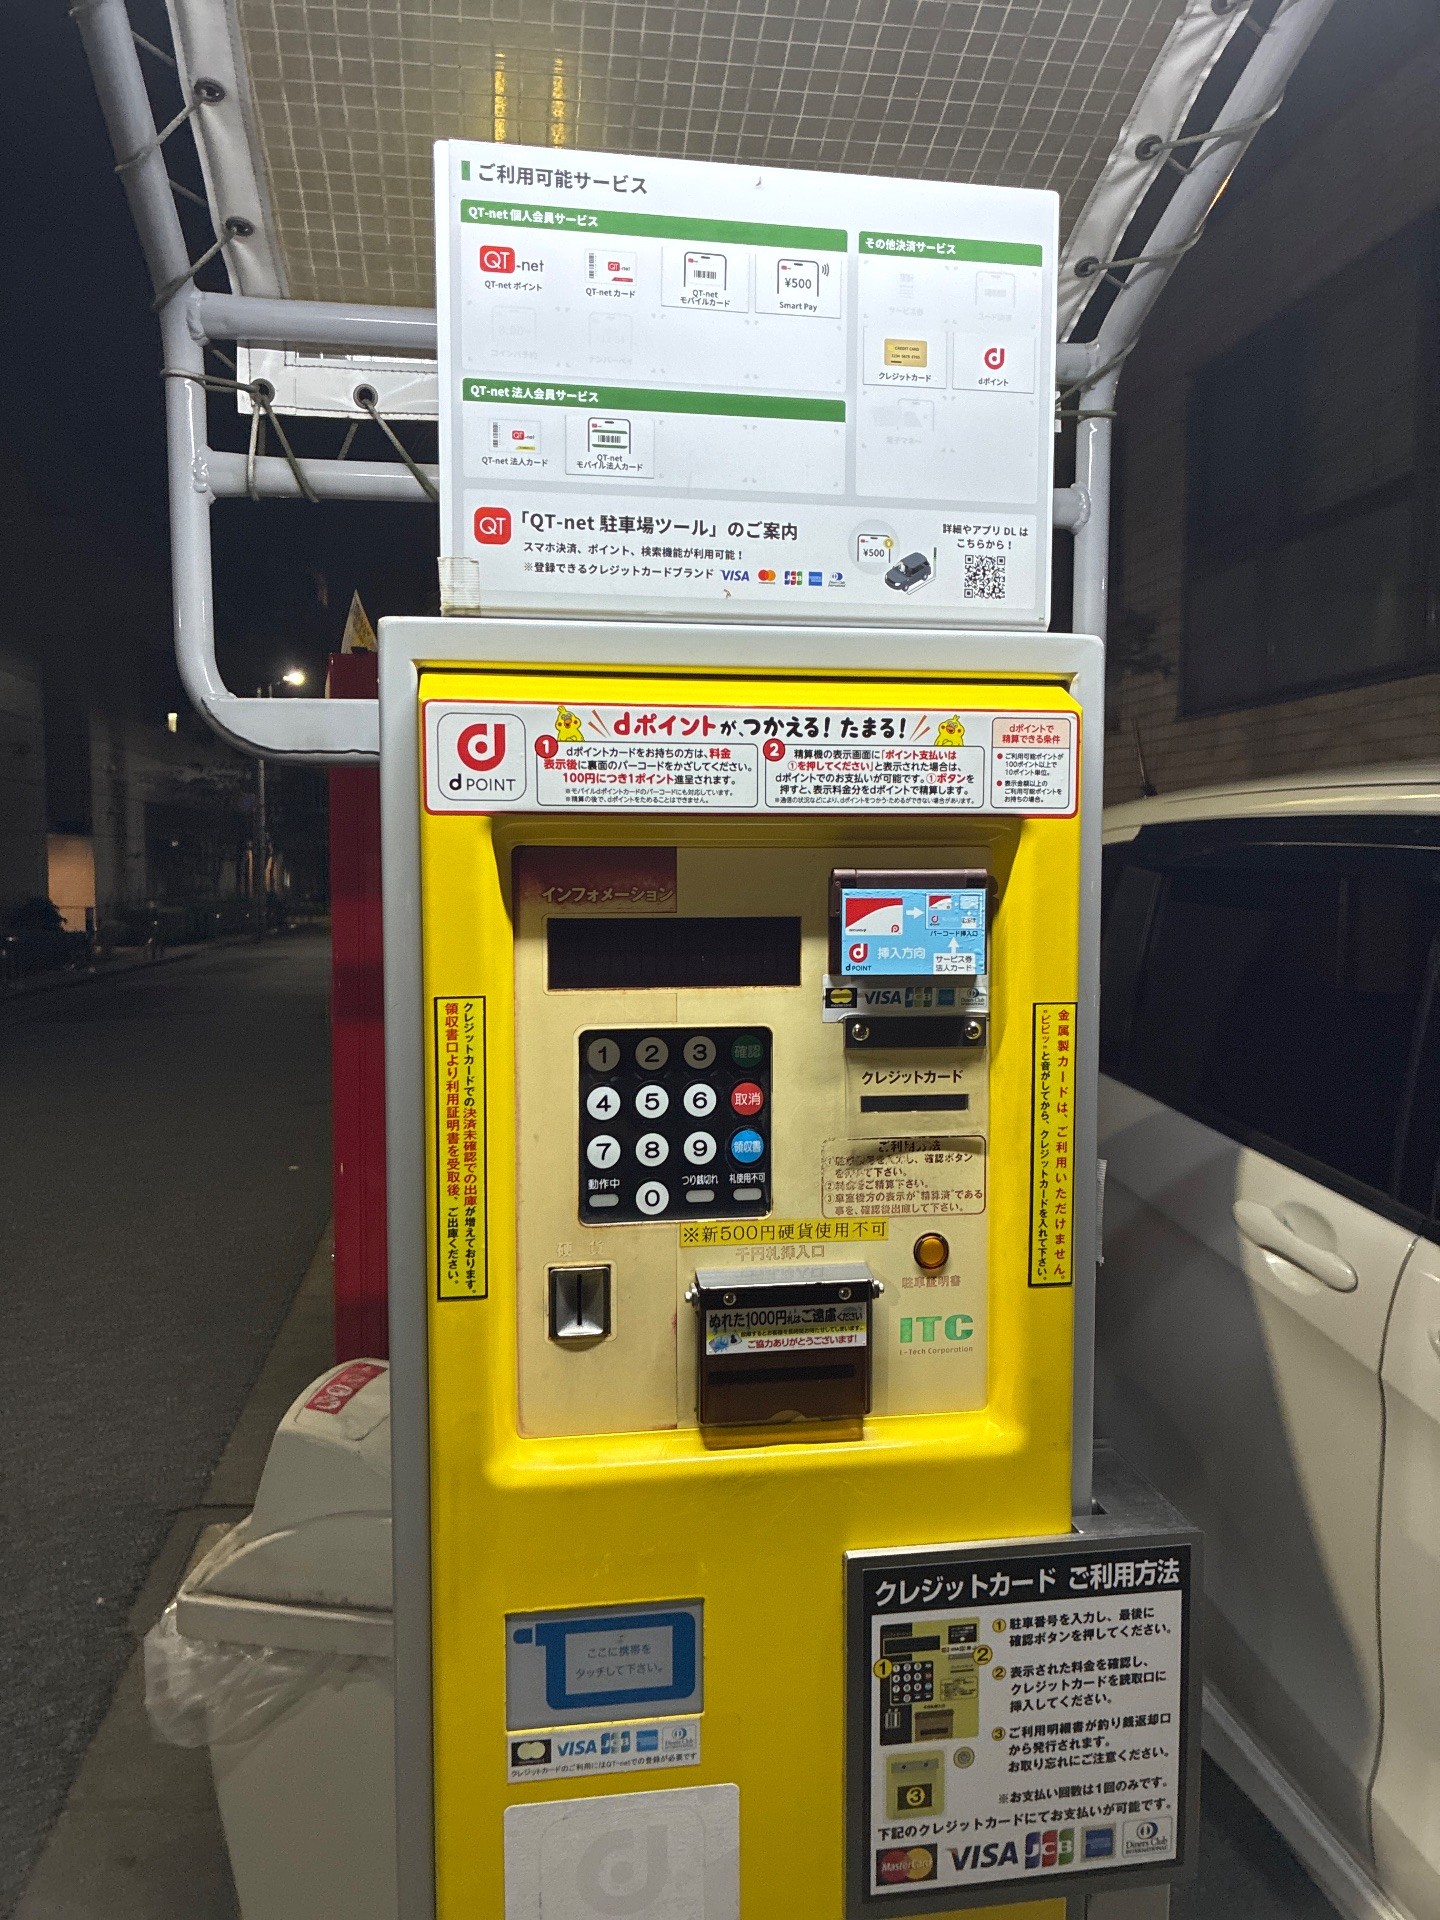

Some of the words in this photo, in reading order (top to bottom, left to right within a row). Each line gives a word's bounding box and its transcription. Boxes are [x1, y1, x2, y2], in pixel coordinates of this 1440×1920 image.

[478, 163, 648, 195] ご利用可能サービス
[468, 206, 508, 221] QT-net
[510, 208, 599, 229] 個人会員サービス
[865, 237, 957, 255] その他決済サービス
[484, 280, 512, 290] QT-net
[513, 282, 543, 292] ポイント
[784, 277, 812, 290] ¥500
[586, 287, 612, 297] QT-net
[613, 289, 636, 299] カード
[692, 289, 719, 299] QT-net
[680, 296, 731, 308] モバイルカード
[779, 301, 803, 311] Smart
[803, 303, 818, 313] Pay
[878, 372, 932, 383] クレジットカード
[978, 377, 1010, 388] dポイント
[469, 384, 510, 399] QT-net
[511, 386, 599, 403] 法人会員サービス
[481, 456, 509, 466] QT-net
[510, 457, 548, 468] 法人カード
[576, 460, 643, 472] モバイル法人カード
[597, 453, 623, 463] QT-net
[943, 523, 1000, 536] 詳細やアプリ
[1004, 528, 1017, 537] DL
[1019, 527, 1029, 537] は
[523, 541, 743, 561] スマホ決済、ポイント、検索機能が利用可能！
[957, 538, 1012, 550] こちらから！
[523, 562, 715, 579] ※登録できるクレジットカードブランド
[720, 569, 750, 582] VISA
[1009, 723, 1054, 733] dポイントで
[1002, 734, 1061, 744] 精算できる条件
[566, 747, 732, 760] dポイントカードをお持ちの方は、料金
[793, 748, 958, 761] 精算機の表示画面に「ポイント支払いは
[1004, 752, 1065, 761] ご利用可能ポイントが
[543, 758, 753, 773] 表示後に裏面のバーコードをかざしてください。
[1004, 760, 1058, 769] 100ポイント以上で
[466, 778, 516, 792] POINT
[563, 773, 737, 786] 100円につき1ポイント進呈されます。
[779, 784, 969, 796] 押すと、表示料金分をdポイントで精算します。
[541, 886, 675, 903] インフォメーション
[877, 946, 926, 960] 挿入方向
[935, 955, 973, 964] サービス券
[935, 964, 973, 972] 法人カード
[864, 990, 902, 1005] VISA
[597, 1046, 607, 1064] 1
[644, 1045, 660, 1063] 2
[692, 1043, 708, 1062] 3
[734, 1045, 761, 1059] 確認
[861, 1069, 964, 1086] クレジットカード
[595, 1094, 612, 1112] 4
[644, 1093, 660, 1110] 5
[692, 1091, 707, 1109] 6
[734, 1092, 761, 1106] 取消
[445, 1002, 460, 1284] 領収書口より利用証明書を受取後、ご出庫ください。
[463, 1002, 477, 1294] クレジットカードでの決済未確認での出庫が増えております。
[644, 1141, 660, 1159] 8
[692, 1139, 708, 1157] 9
[733, 1140, 762, 1154] 領収書
[1053, 1008, 1070, 1280] 金属製カードは、ご利用いただけません。
[595, 1142, 612, 1161] 7
[588, 1178, 620, 1190] 動作中
[681, 1174, 719, 1185] つり銭切れ
[729, 1172, 766, 1184] 札使用不可
[644, 1189, 660, 1207] 0
[835, 1203, 964, 1216] 事を、確認後出庫して下さい。
[683, 1221, 887, 1243] ※新500円硬貨使用不可
[736, 1244, 825, 1262] 千円札挿入口
[901, 1274, 961, 1289] 駐車証明書
[709, 1307, 863, 1328] ぬれた1000円札はご遠慮ください
[900, 1313, 974, 1344] ITC
[927, 1346, 973, 1356] Corporation
[875, 1568, 1057, 1607] クレジットカード
[1068, 1558, 1180, 1591] ご利用方法
[1009, 1607, 1155, 1630] 駐車番号を入力し、最後に
[1009, 1623, 1172, 1648] 確認ボタンを押してください。
[587, 1643, 652, 1659] ここに携帯を
[575, 1662, 663, 1680] タッチして下さい。
[1010, 1655, 1149, 1679] 表示された料金を確認し、
[1010, 1670, 1167, 1696] クレジットカードを読取口に
[1009, 1693, 1112, 1713] 挿入してください。
[1008, 1712, 1172, 1739] ご利用明細書が釣り銭返却口
[557, 1739, 597, 1757] VISA
[1008, 1735, 1110, 1756] から発行されます。
[1008, 1746, 1169, 1773] お取り忘れにご注意ください。
[877, 1797, 1172, 1841] 下記のクレジットカードにてお支払いが可能です。
[945, 1841, 1019, 1871] VISA
[1024, 1827, 1075, 1870] JCB
[1150, 1836, 1168, 1846] Club
